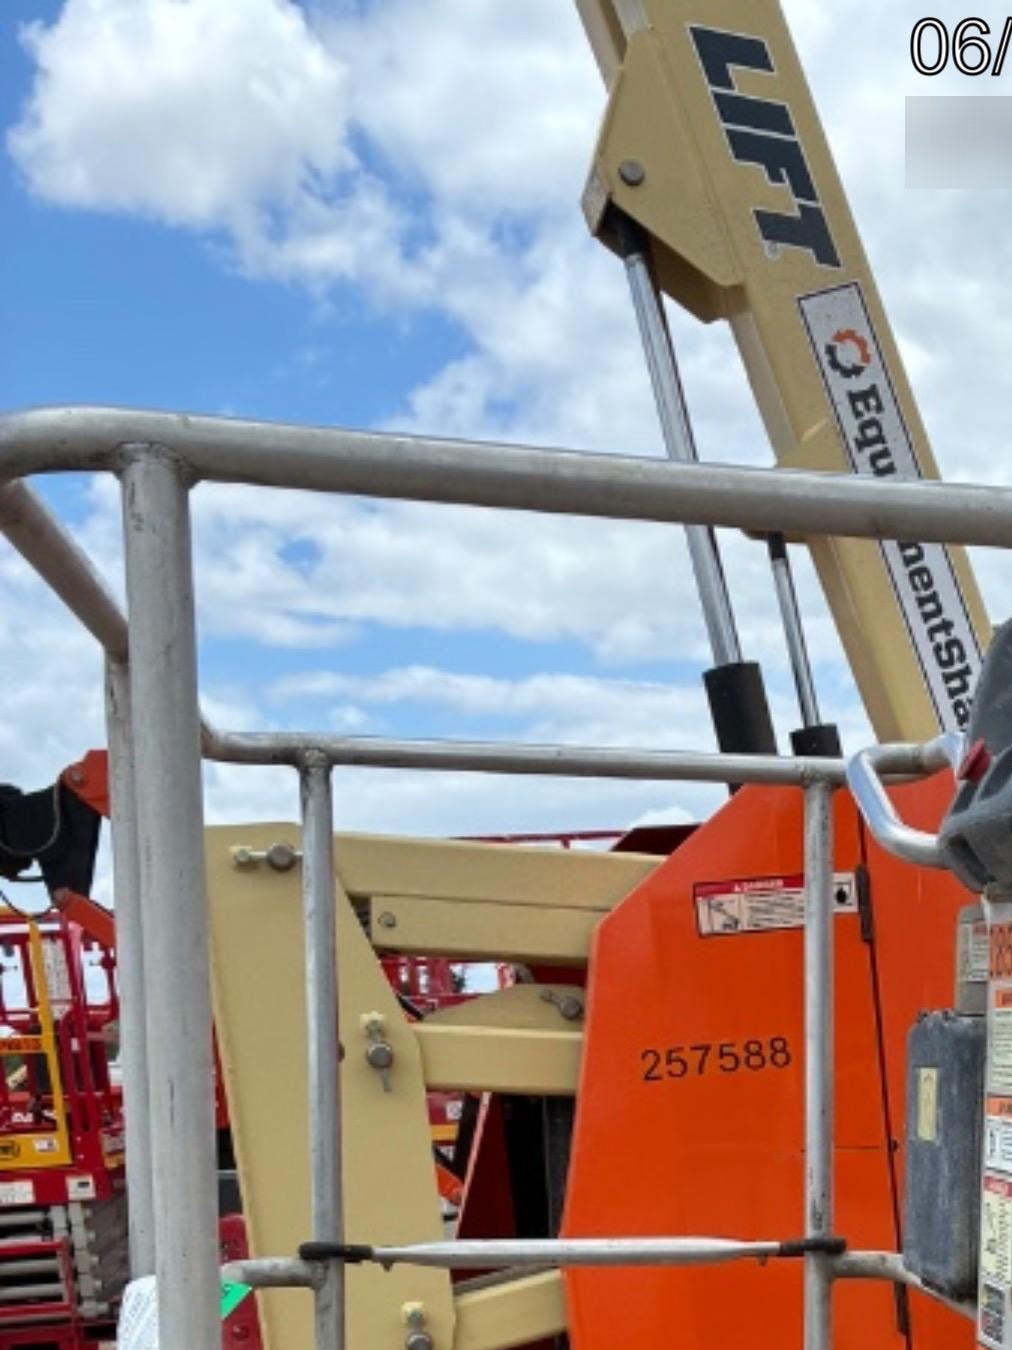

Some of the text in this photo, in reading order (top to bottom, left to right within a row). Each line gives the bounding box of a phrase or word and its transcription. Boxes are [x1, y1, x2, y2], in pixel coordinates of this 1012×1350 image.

[688, 25, 842, 269] LIFT
[846, 383, 973, 733] EqumentSha
[641, 1037, 792, 1082] 257588
